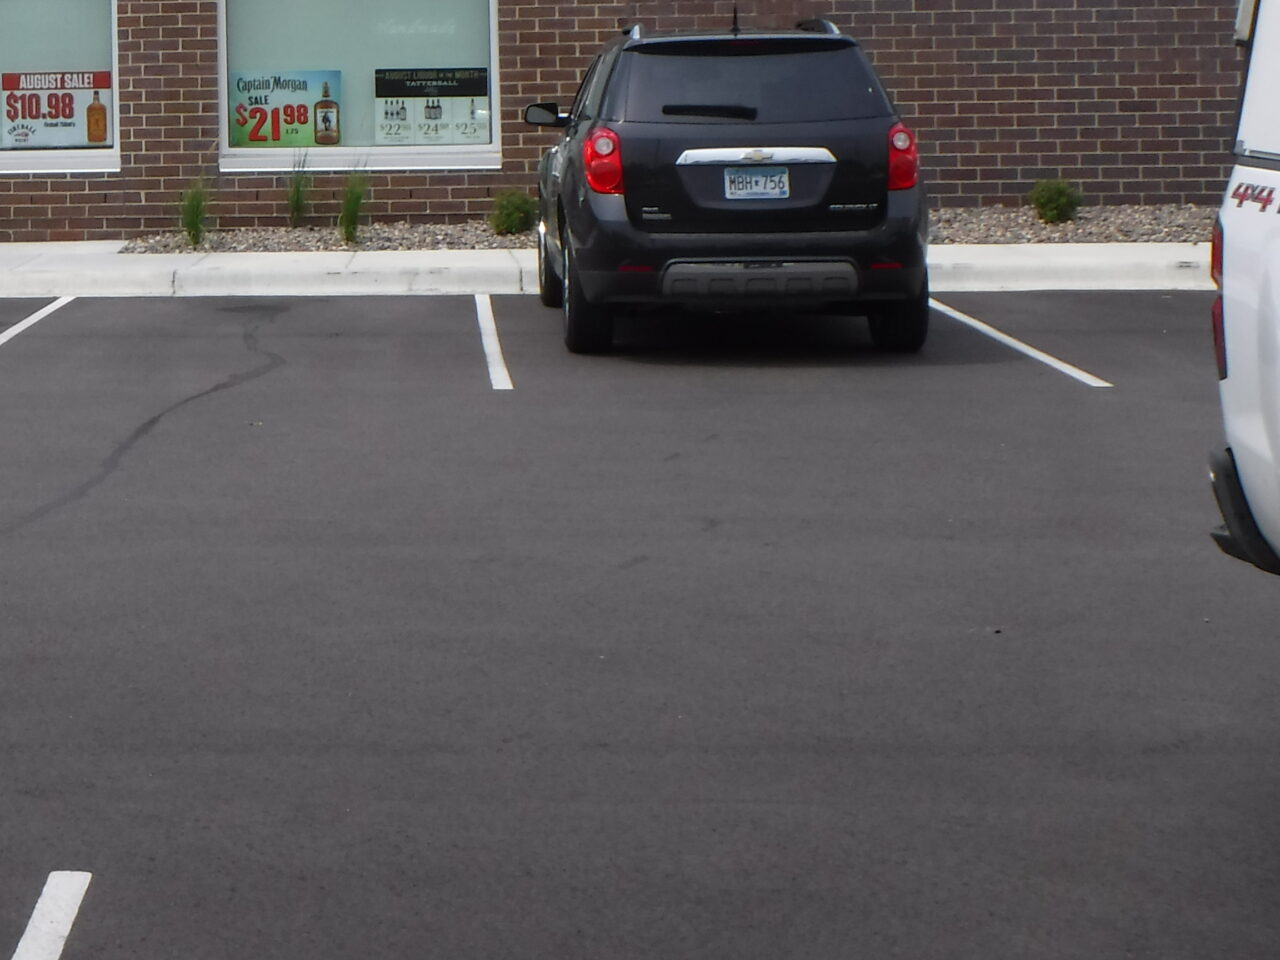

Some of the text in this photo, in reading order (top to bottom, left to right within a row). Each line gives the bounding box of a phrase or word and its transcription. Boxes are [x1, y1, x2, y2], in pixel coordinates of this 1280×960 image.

[19, 72, 94, 89] AUGUST SALE!
[236, 76, 308, 93] Captain Morgan
[5, 91, 74, 122] $10.98
[248, 95, 269, 106] SALE
[729, 174, 785, 191] MBH 756
